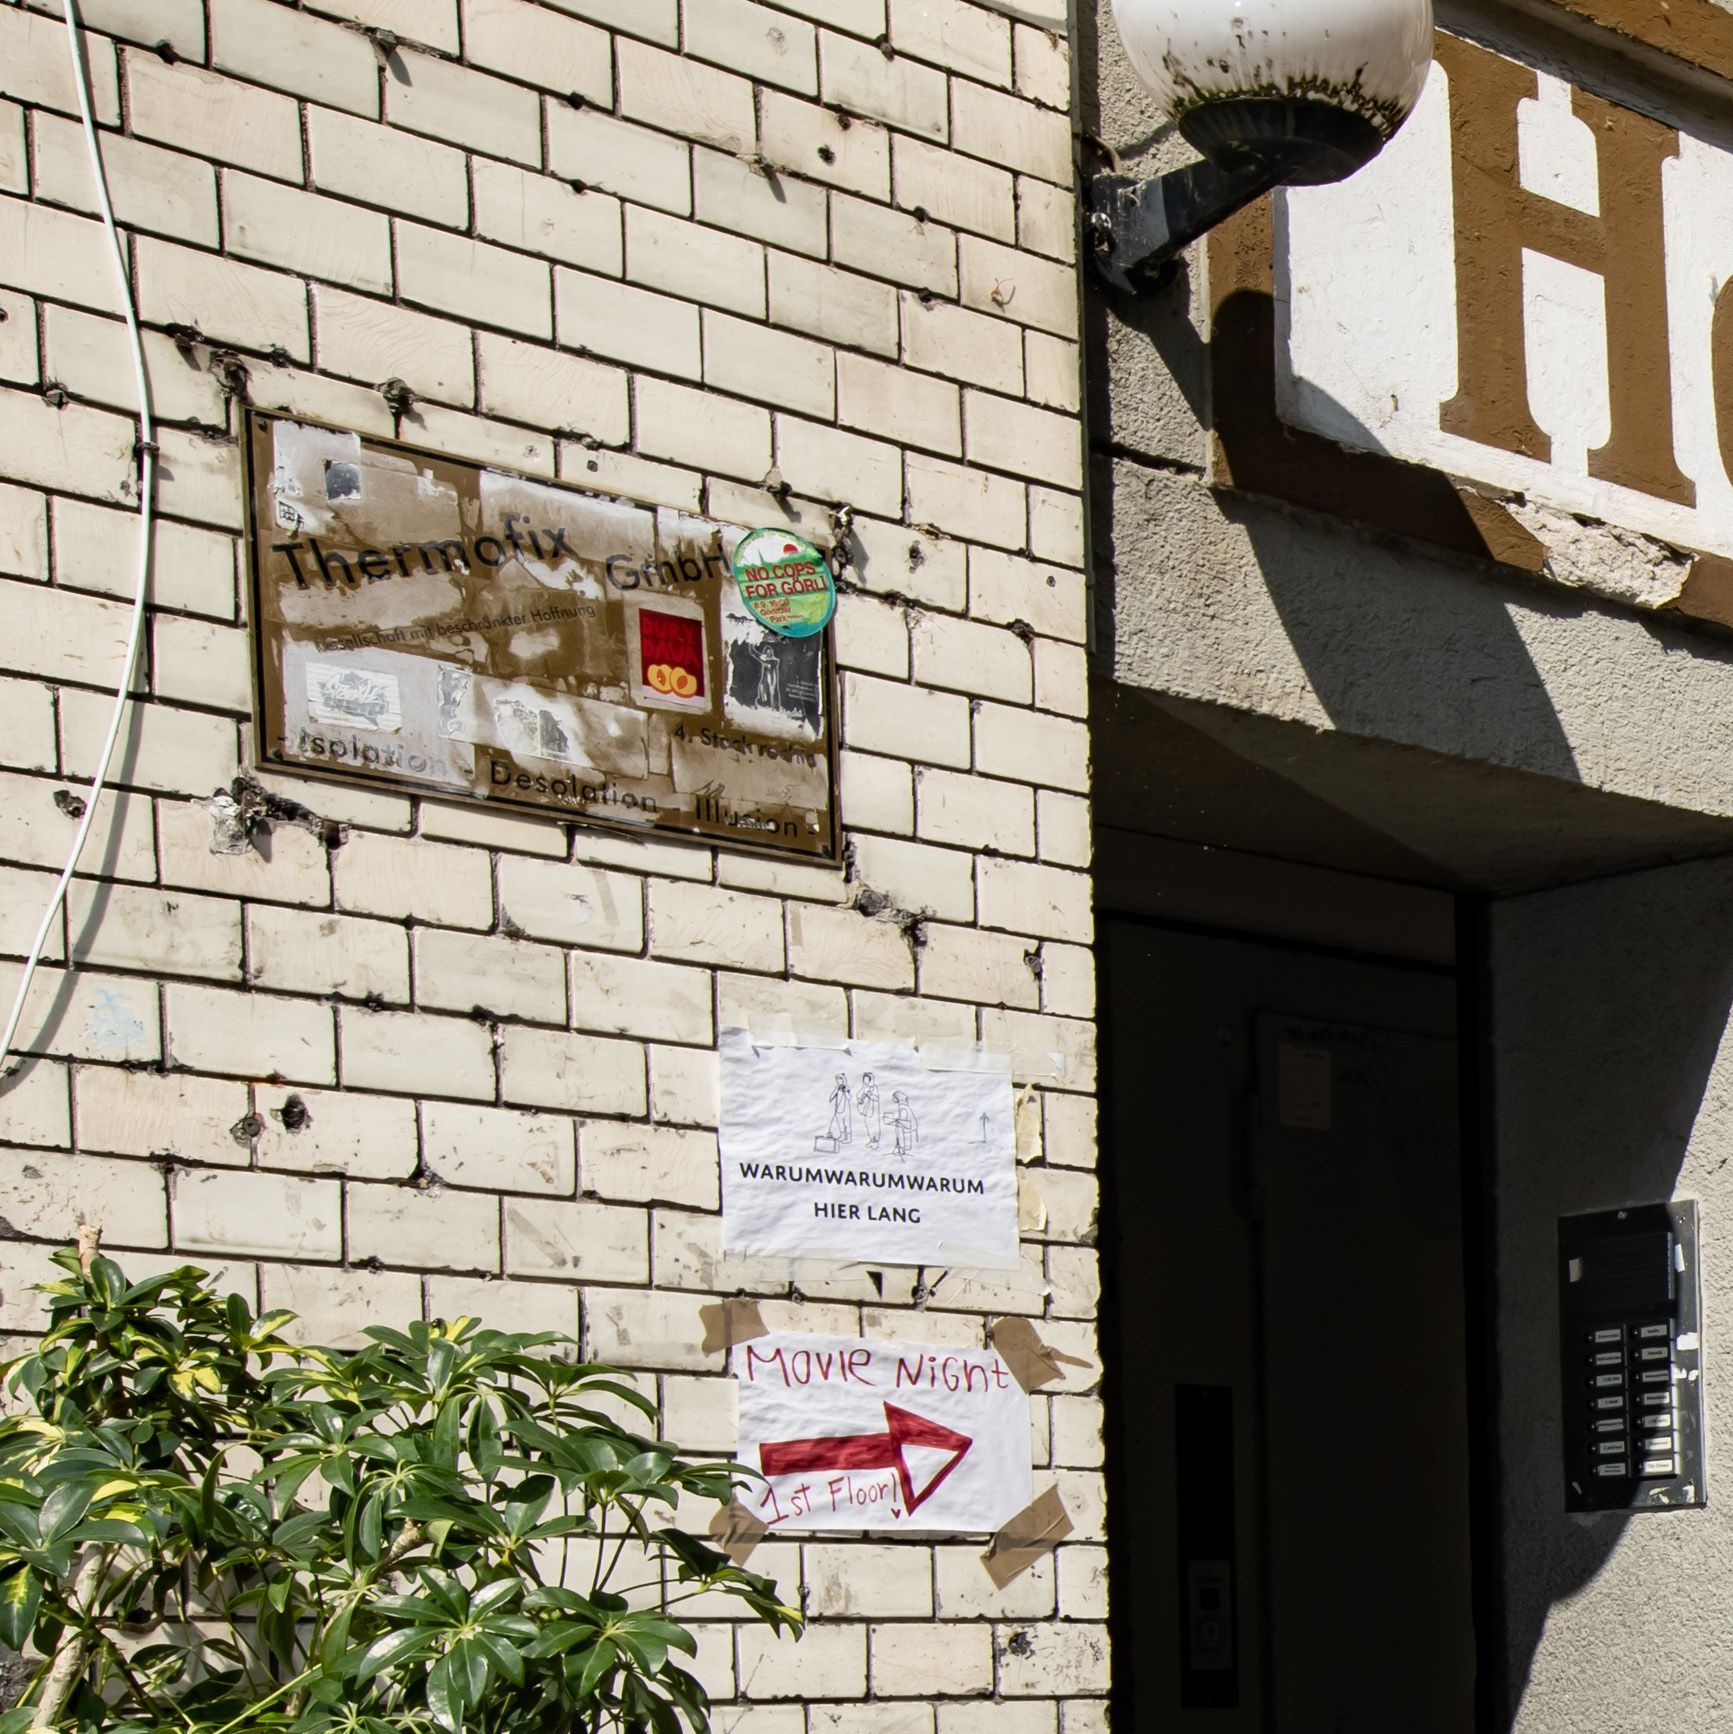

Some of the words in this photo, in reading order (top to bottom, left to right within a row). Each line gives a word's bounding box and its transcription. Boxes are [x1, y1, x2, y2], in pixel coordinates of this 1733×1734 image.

[272, 512, 577, 590] Thermofix
[605, 543, 732, 591] GmbH
[745, 566, 769, 581] NO
[771, 561, 816, 579] COPS
[745, 582, 779, 599] FOR
[780, 575, 828, 595] GÖRLI
[409, 624, 432, 642] mit
[435, 613, 527, 638] beschränkter
[532, 605, 596, 623] Hoffnung
[299, 727, 448, 777] Isolation
[490, 761, 657, 812] Desolation
[695, 794, 798, 838] Illusion
[739, 1162, 984, 1195] WARUMWARUMWARUM
[814, 1202, 860, 1220] HIER
[868, 1205, 921, 1224] LANG
[760, 1482, 811, 1525] 1st
